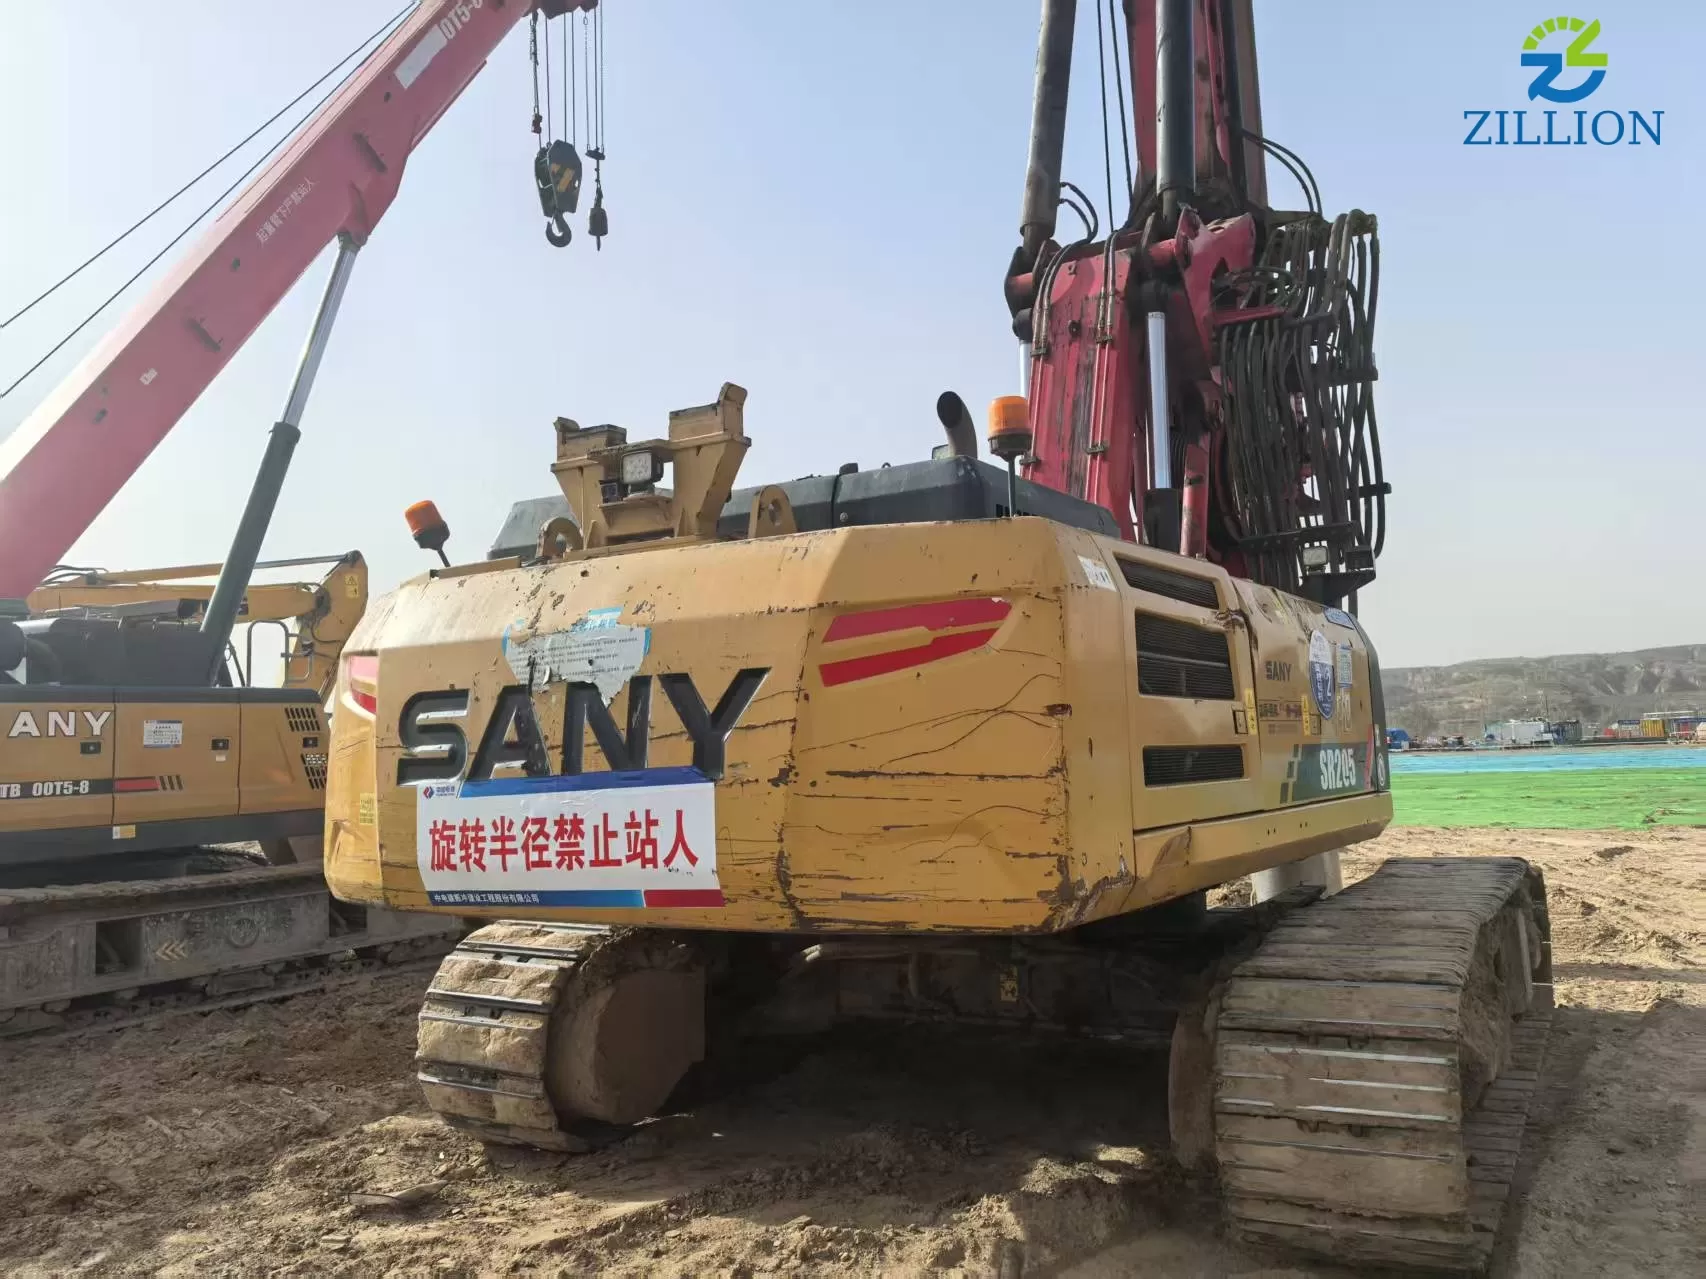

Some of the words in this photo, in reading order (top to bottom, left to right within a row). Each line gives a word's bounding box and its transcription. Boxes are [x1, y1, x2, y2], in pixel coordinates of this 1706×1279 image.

[1265, 660, 1293, 681] SANY
[8, 711, 112, 737] ANY
[397, 666, 773, 786] SANY
[32, 780, 89, 796] 00T5-8
[428, 809, 699, 872] 旋转半径禁止站人
